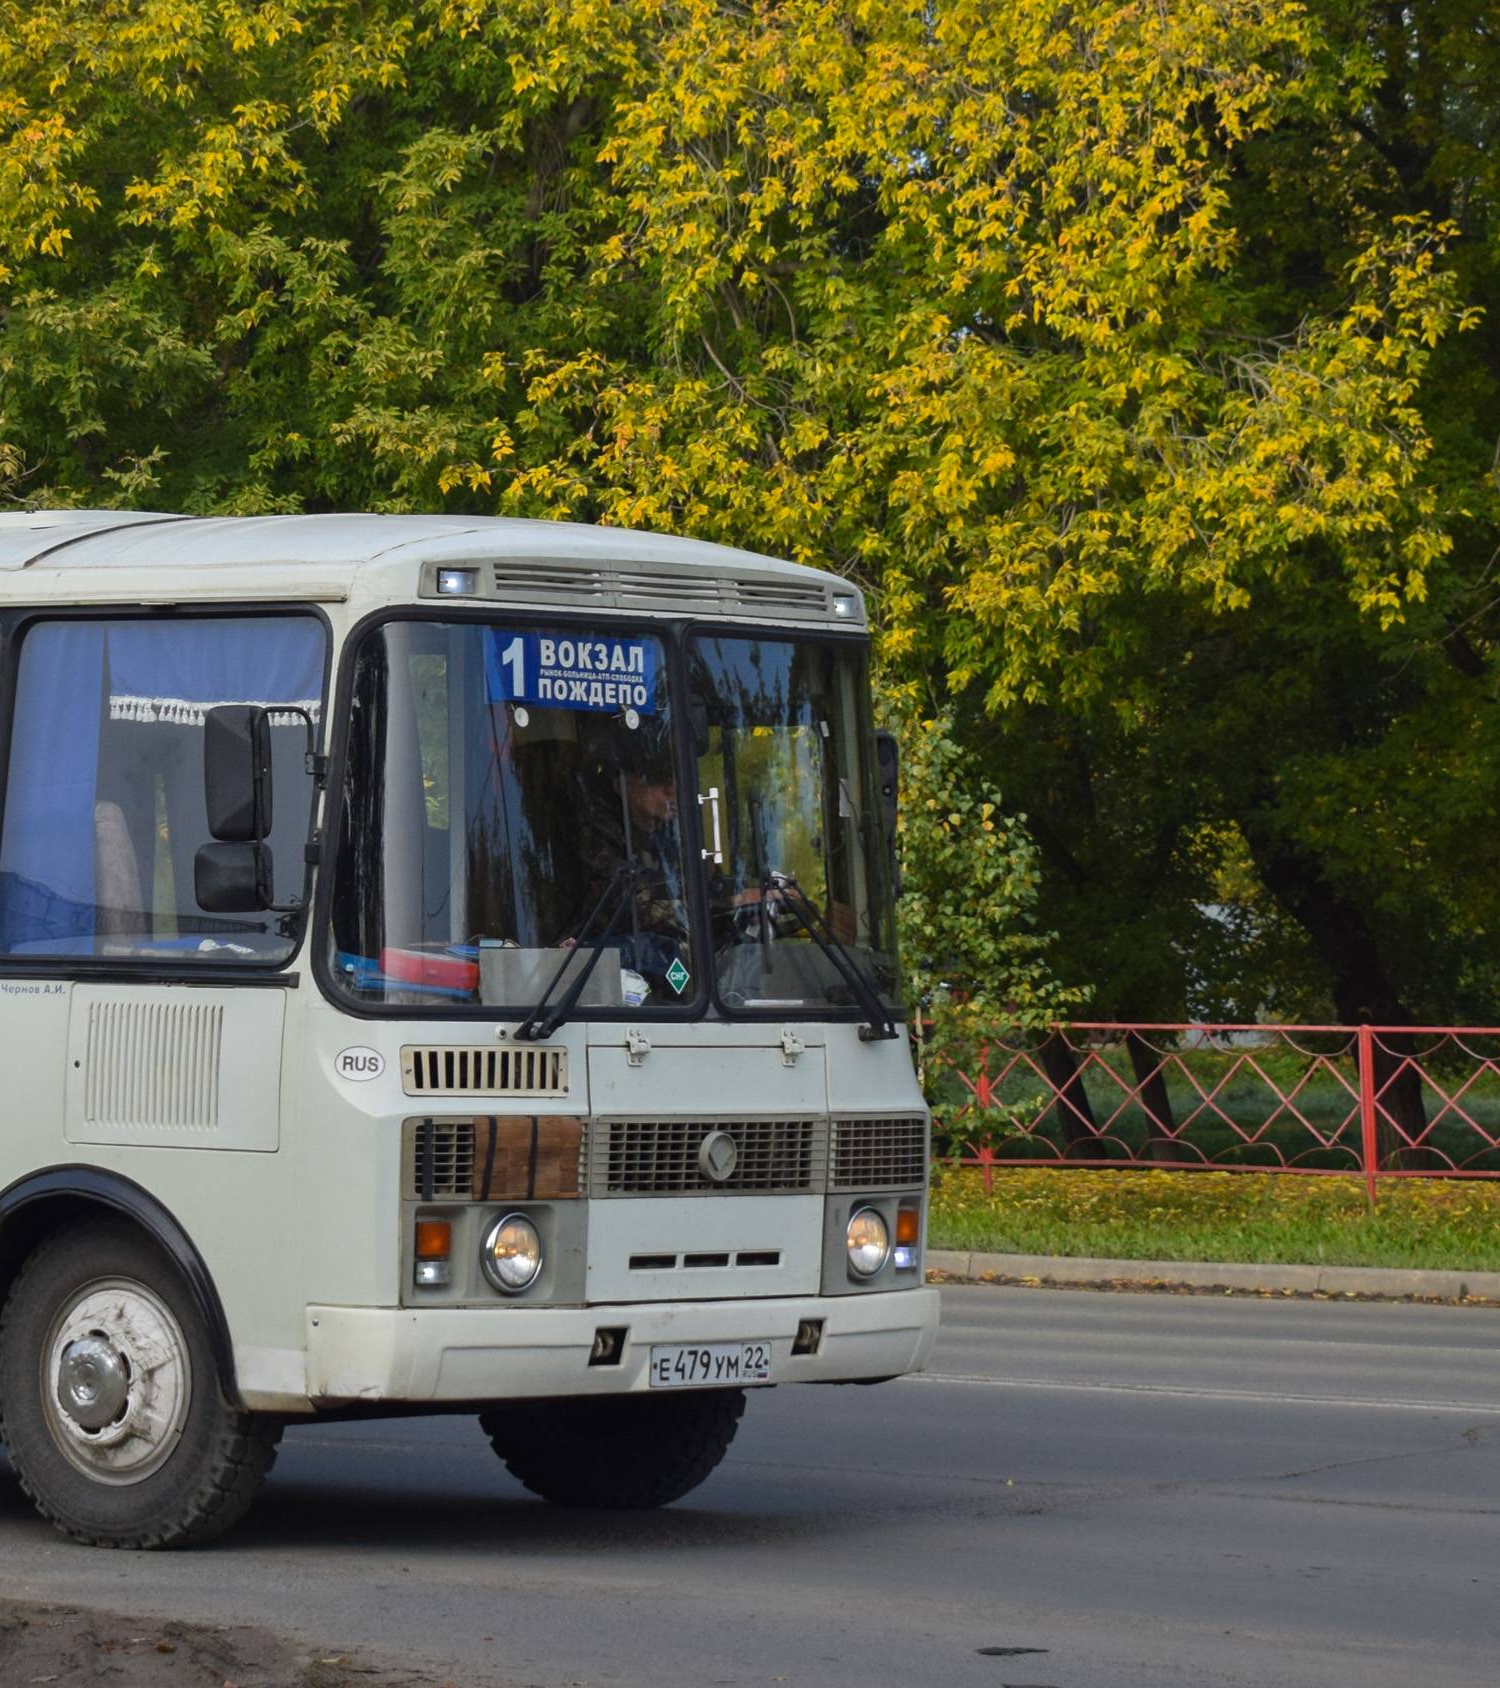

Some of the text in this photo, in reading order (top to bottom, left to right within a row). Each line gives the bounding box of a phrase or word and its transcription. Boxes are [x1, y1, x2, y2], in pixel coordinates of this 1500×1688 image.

[502, 637, 525, 697] 1
[540, 639, 644, 673] ВОКЗАЛ
[538, 678, 647, 706] ПОЖДЕПО
[1, 984, 40, 995] Чернов
[342, 1055, 379, 1072] RUS
[744, 1346, 764, 1369] 22
